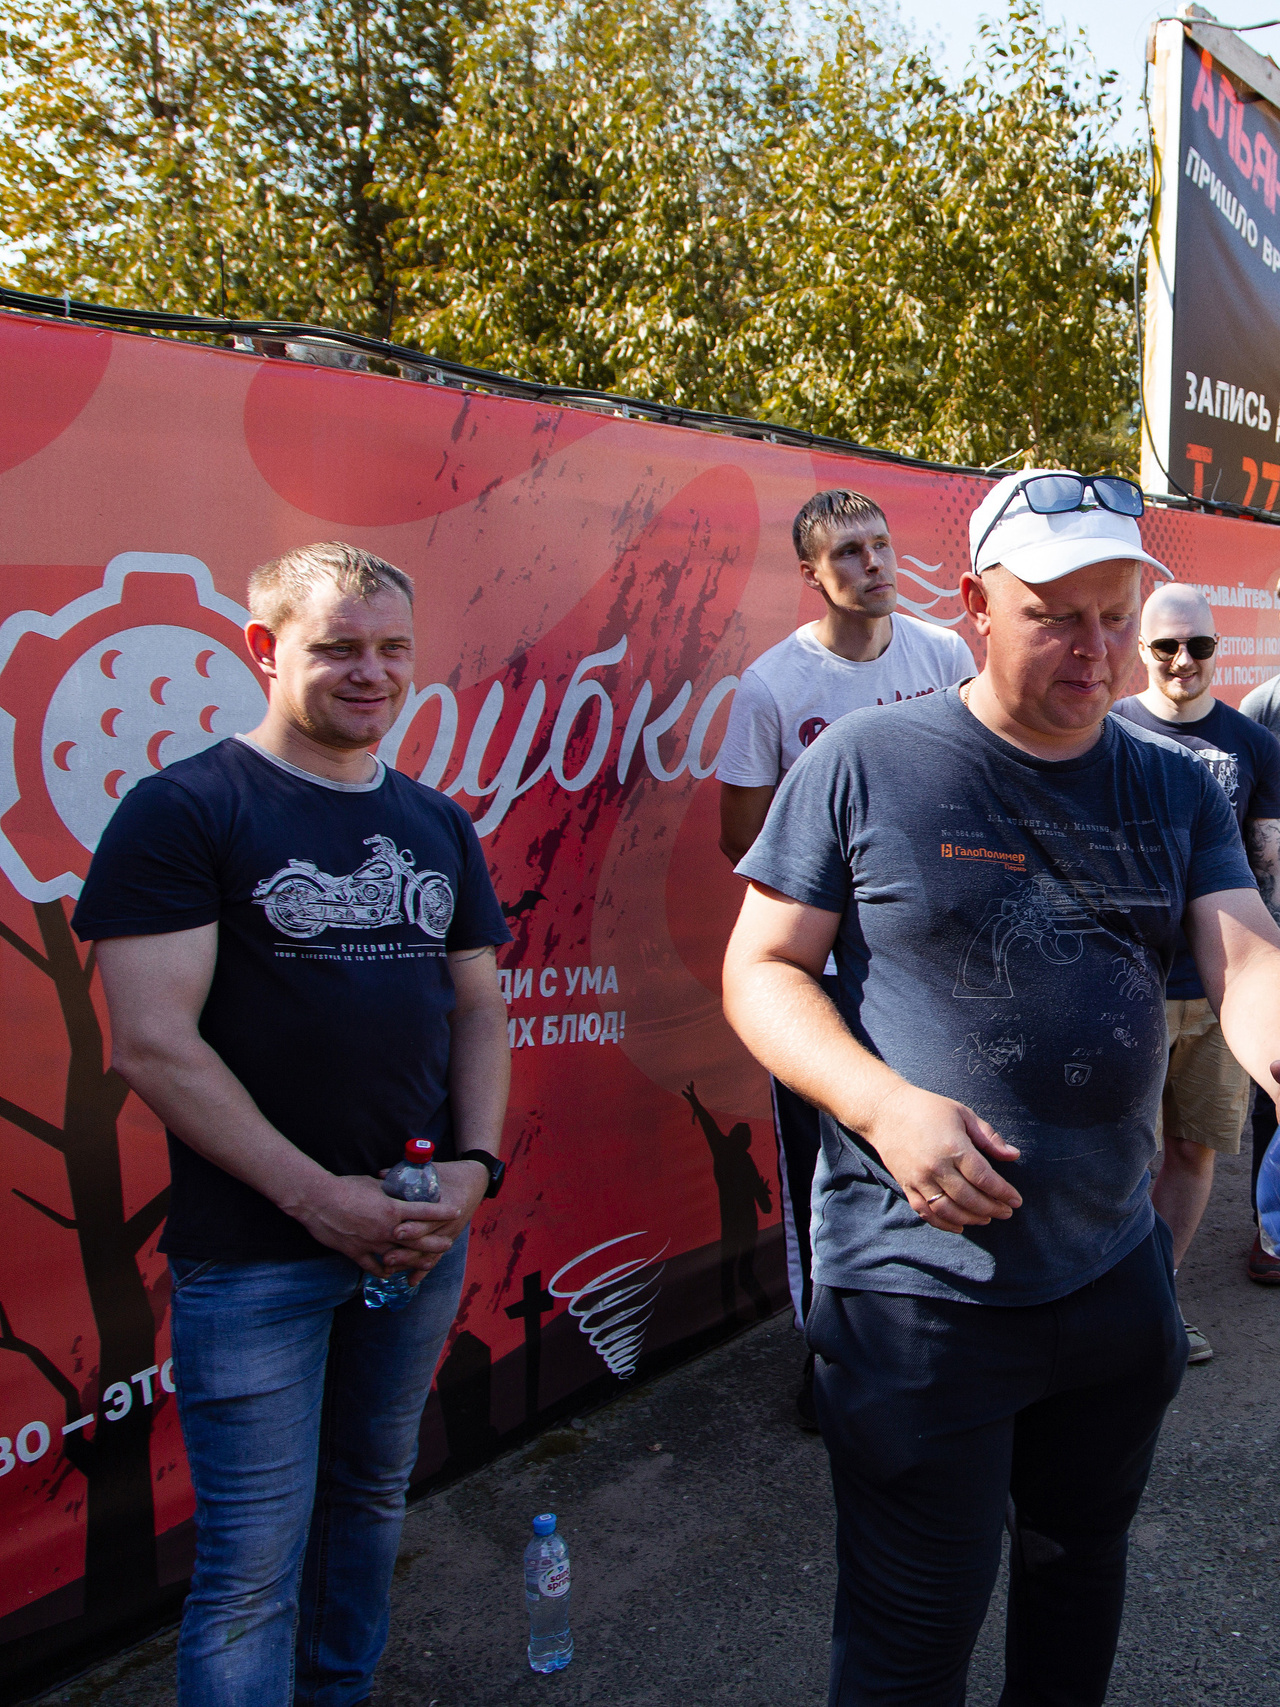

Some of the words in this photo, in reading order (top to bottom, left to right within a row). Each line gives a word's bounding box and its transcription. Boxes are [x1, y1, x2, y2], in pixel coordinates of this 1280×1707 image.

[1185, 146, 1258, 248] ПРИШЛО
[1184, 370, 1272, 432] ЗАПИСЬ
[954, 846, 1026, 864] ГалоПолимер
[1004, 863, 1027, 873] Пермь
[274, 951, 297, 959] YOUR
[300, 953, 342, 961] LIFESTYLE
[341, 942, 402, 953] SPEEDWAY
[539, 966, 558, 998] С
[564, 965, 619, 997] УМА
[542, 1010, 626, 1046] БЛЮД!
